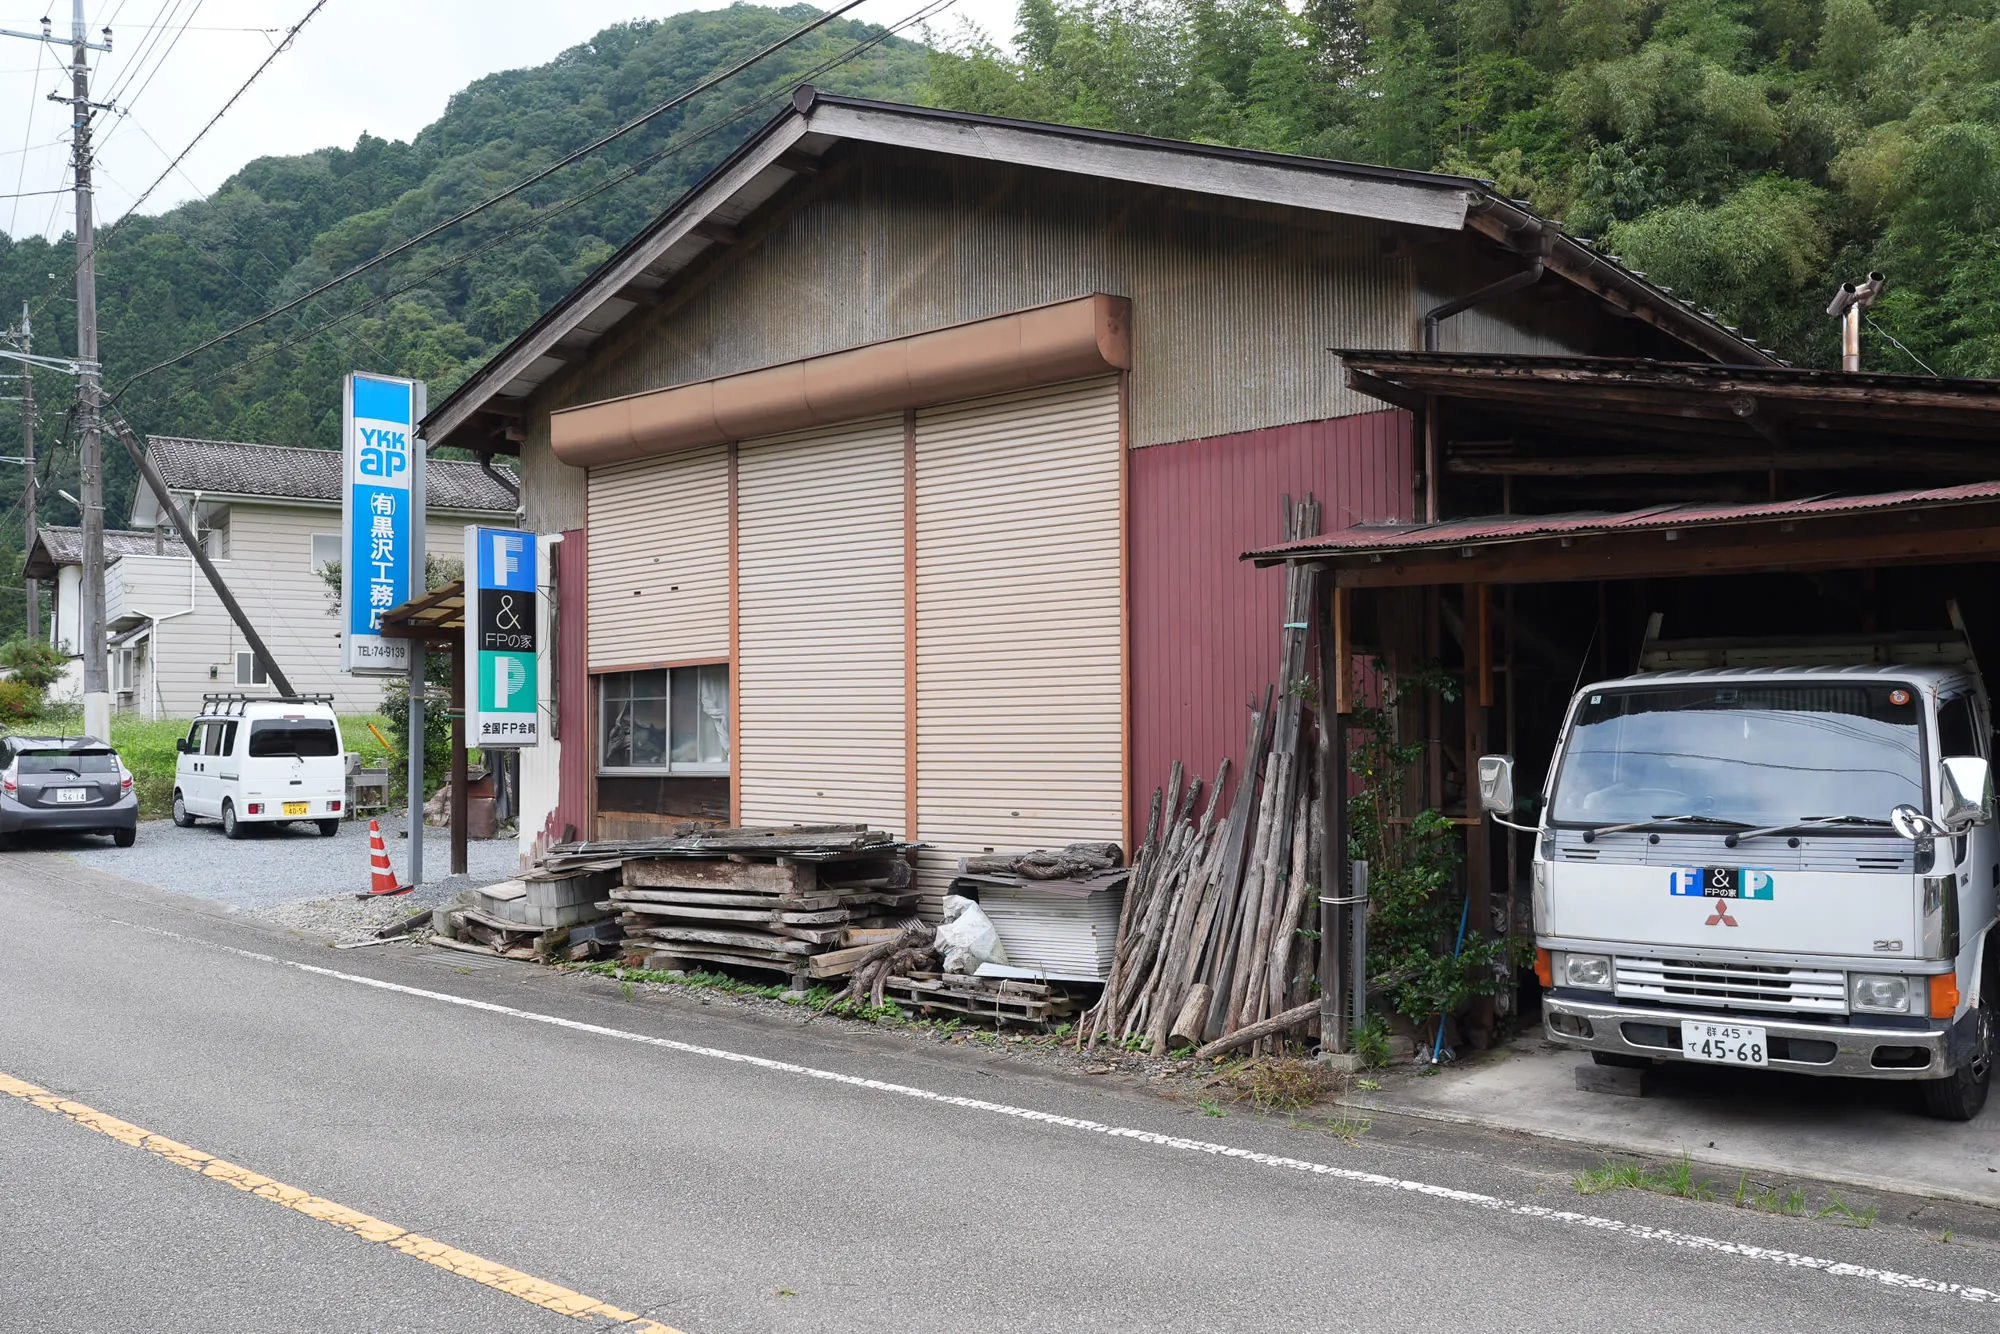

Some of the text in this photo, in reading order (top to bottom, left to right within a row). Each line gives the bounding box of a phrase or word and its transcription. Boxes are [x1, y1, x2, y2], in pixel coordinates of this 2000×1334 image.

[360, 428, 405, 451] YKK
[360, 448, 406, 477] ap
[492, 535, 523, 586] F
[496, 595, 521, 629] &
[485, 633, 532, 648] FPの家
[494, 656, 526, 709] P
[482, 722, 536, 735] 全国FP会員
[1676, 867, 1768, 898] F & P
[1704, 888, 1737, 898] FPの家
[1721, 1028, 1740, 1039] 45
[1701, 1039, 1763, 1063] 45-68
